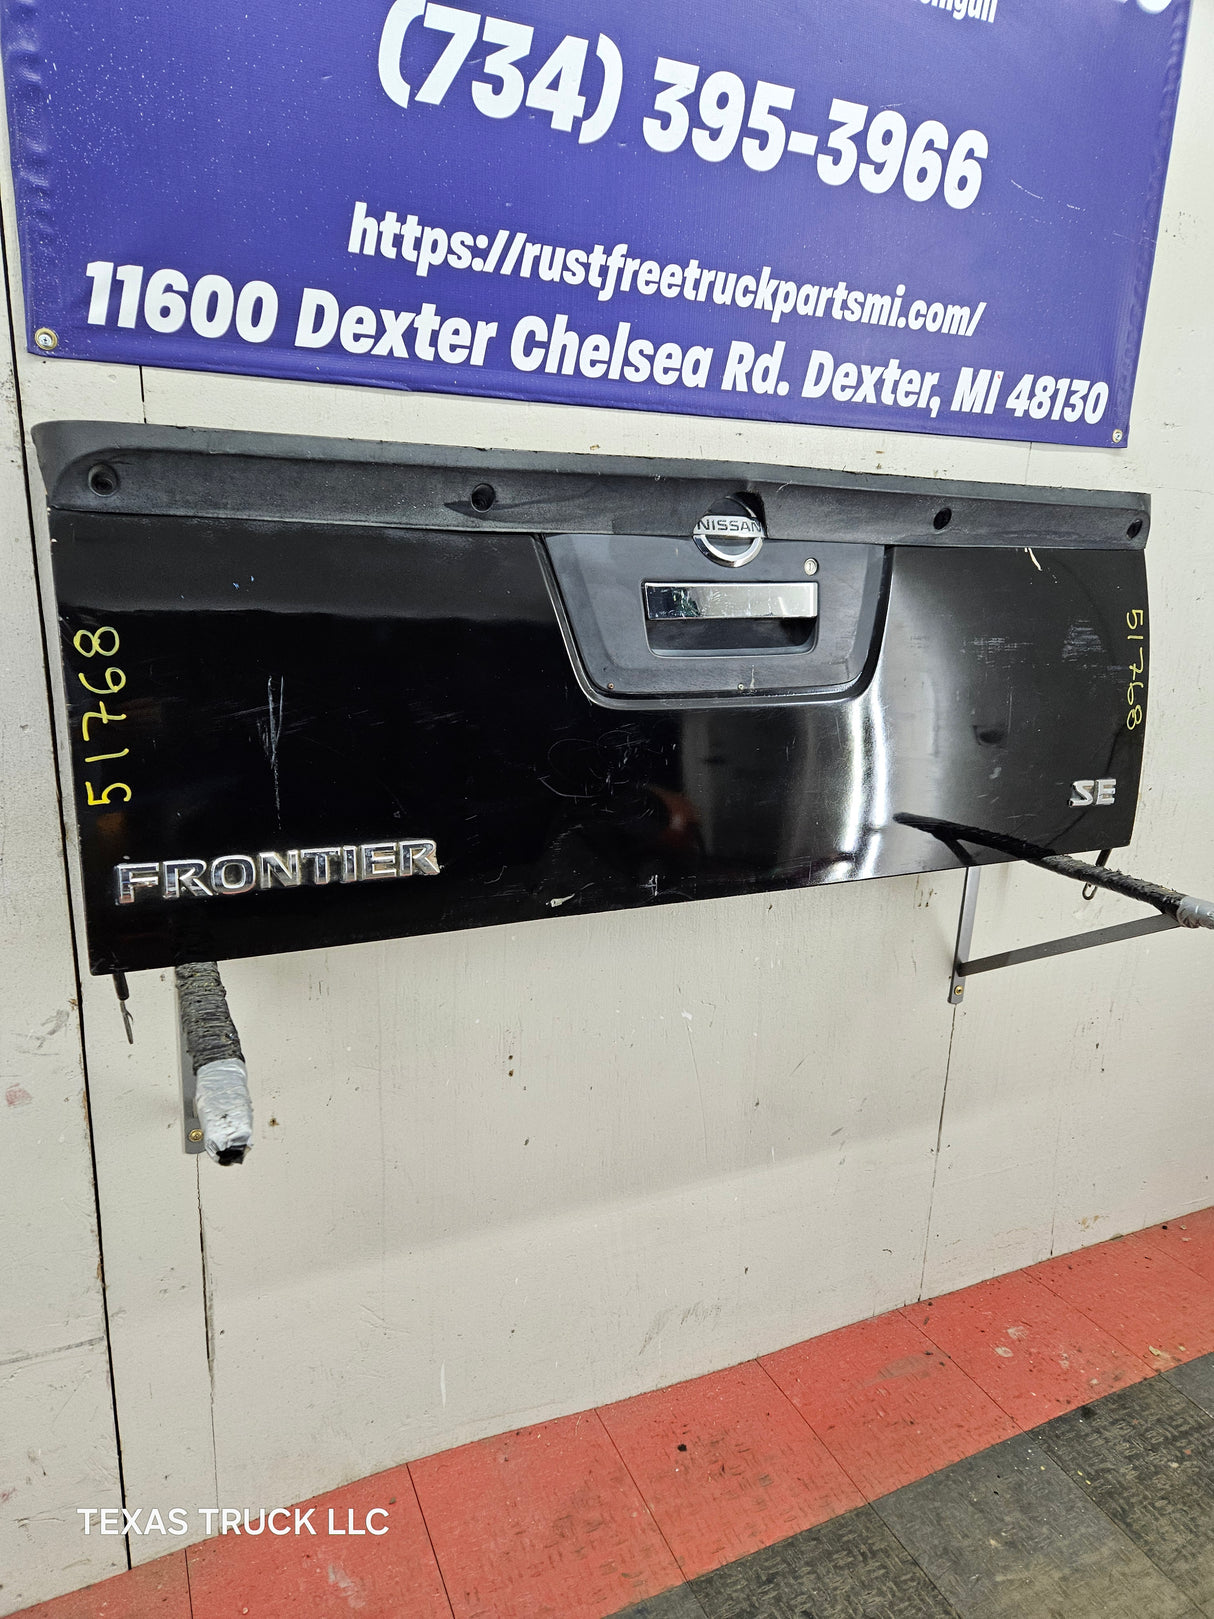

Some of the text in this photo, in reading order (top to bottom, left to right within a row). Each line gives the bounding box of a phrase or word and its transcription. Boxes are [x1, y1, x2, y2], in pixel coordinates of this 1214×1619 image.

[378, 0, 988, 210] (734) 395-3966
[347, 201, 987, 337] https://rustfreetruckpartsmi.com/
[86, 261, 1109, 425] 11600 Dexter Chelsea Rd. Dexter, MI 48130
[697, 519, 762, 533] NISSAN
[73, 626, 132, 806] 51768
[1126, 609, 1144, 731] 51768
[1067, 778, 1117, 808] SE
[114, 839, 441, 905] FRONTIER
